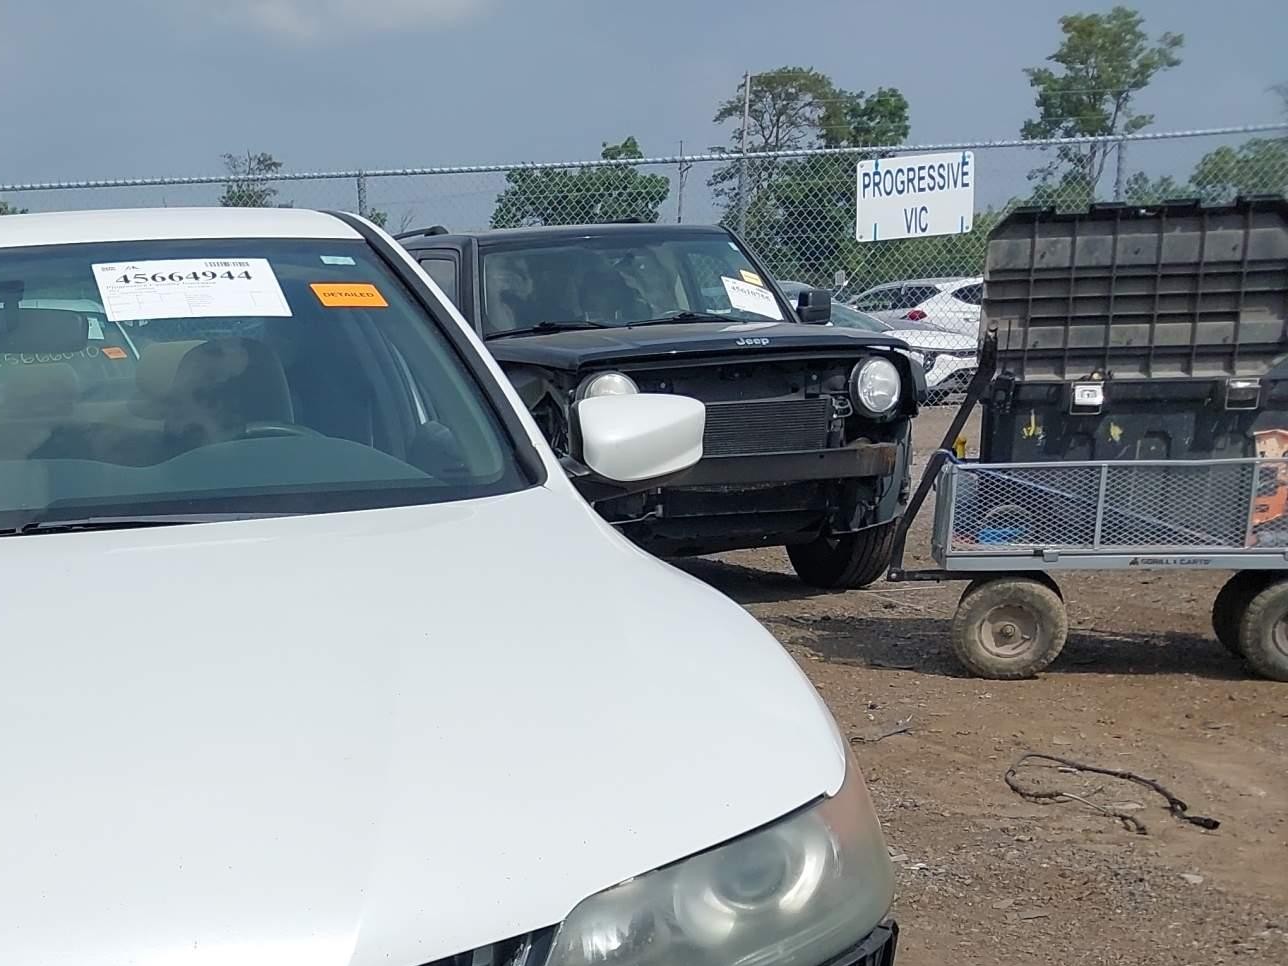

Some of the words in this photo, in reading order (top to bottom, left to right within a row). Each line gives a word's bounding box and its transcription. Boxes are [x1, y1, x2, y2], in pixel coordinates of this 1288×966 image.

[862, 161, 970, 199] PROGRESSIVE
[903, 206, 929, 234] VIC
[115, 269, 253, 284] 45664944
[735, 337, 770, 346] Jeep
